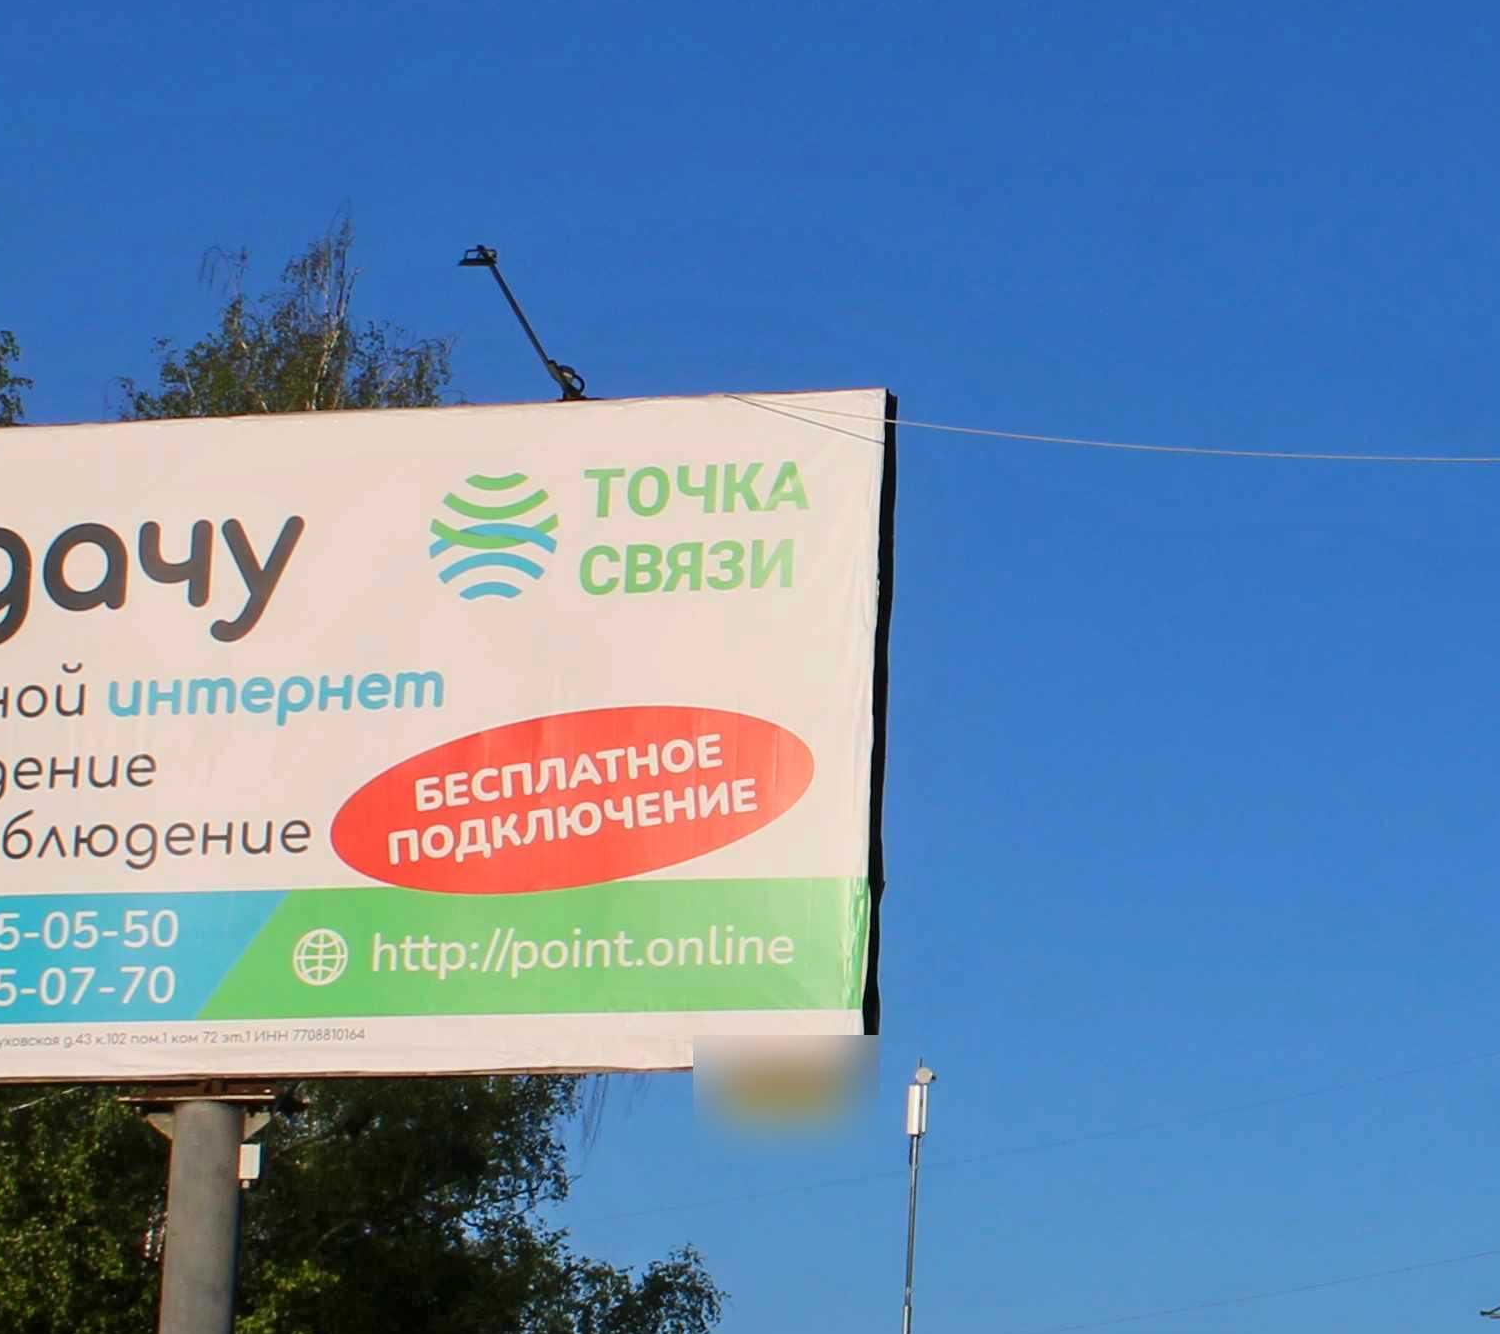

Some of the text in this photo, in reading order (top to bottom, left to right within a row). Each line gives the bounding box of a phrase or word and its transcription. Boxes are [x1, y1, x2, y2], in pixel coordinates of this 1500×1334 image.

[583, 460, 811, 519] ТОЧКА
[578, 538, 796, 596] СВЯЗИ
[107, 669, 445, 726] интернет
[414, 733, 724, 812] БЕСПЛАТНОЕ
[387, 777, 759, 866] ПОДКЛЮЧЕНИЕ
[371, 924, 796, 981] http://point.online
[202, 1030, 219, 1044] 72
[254, 1030, 289, 1043] ИНН
